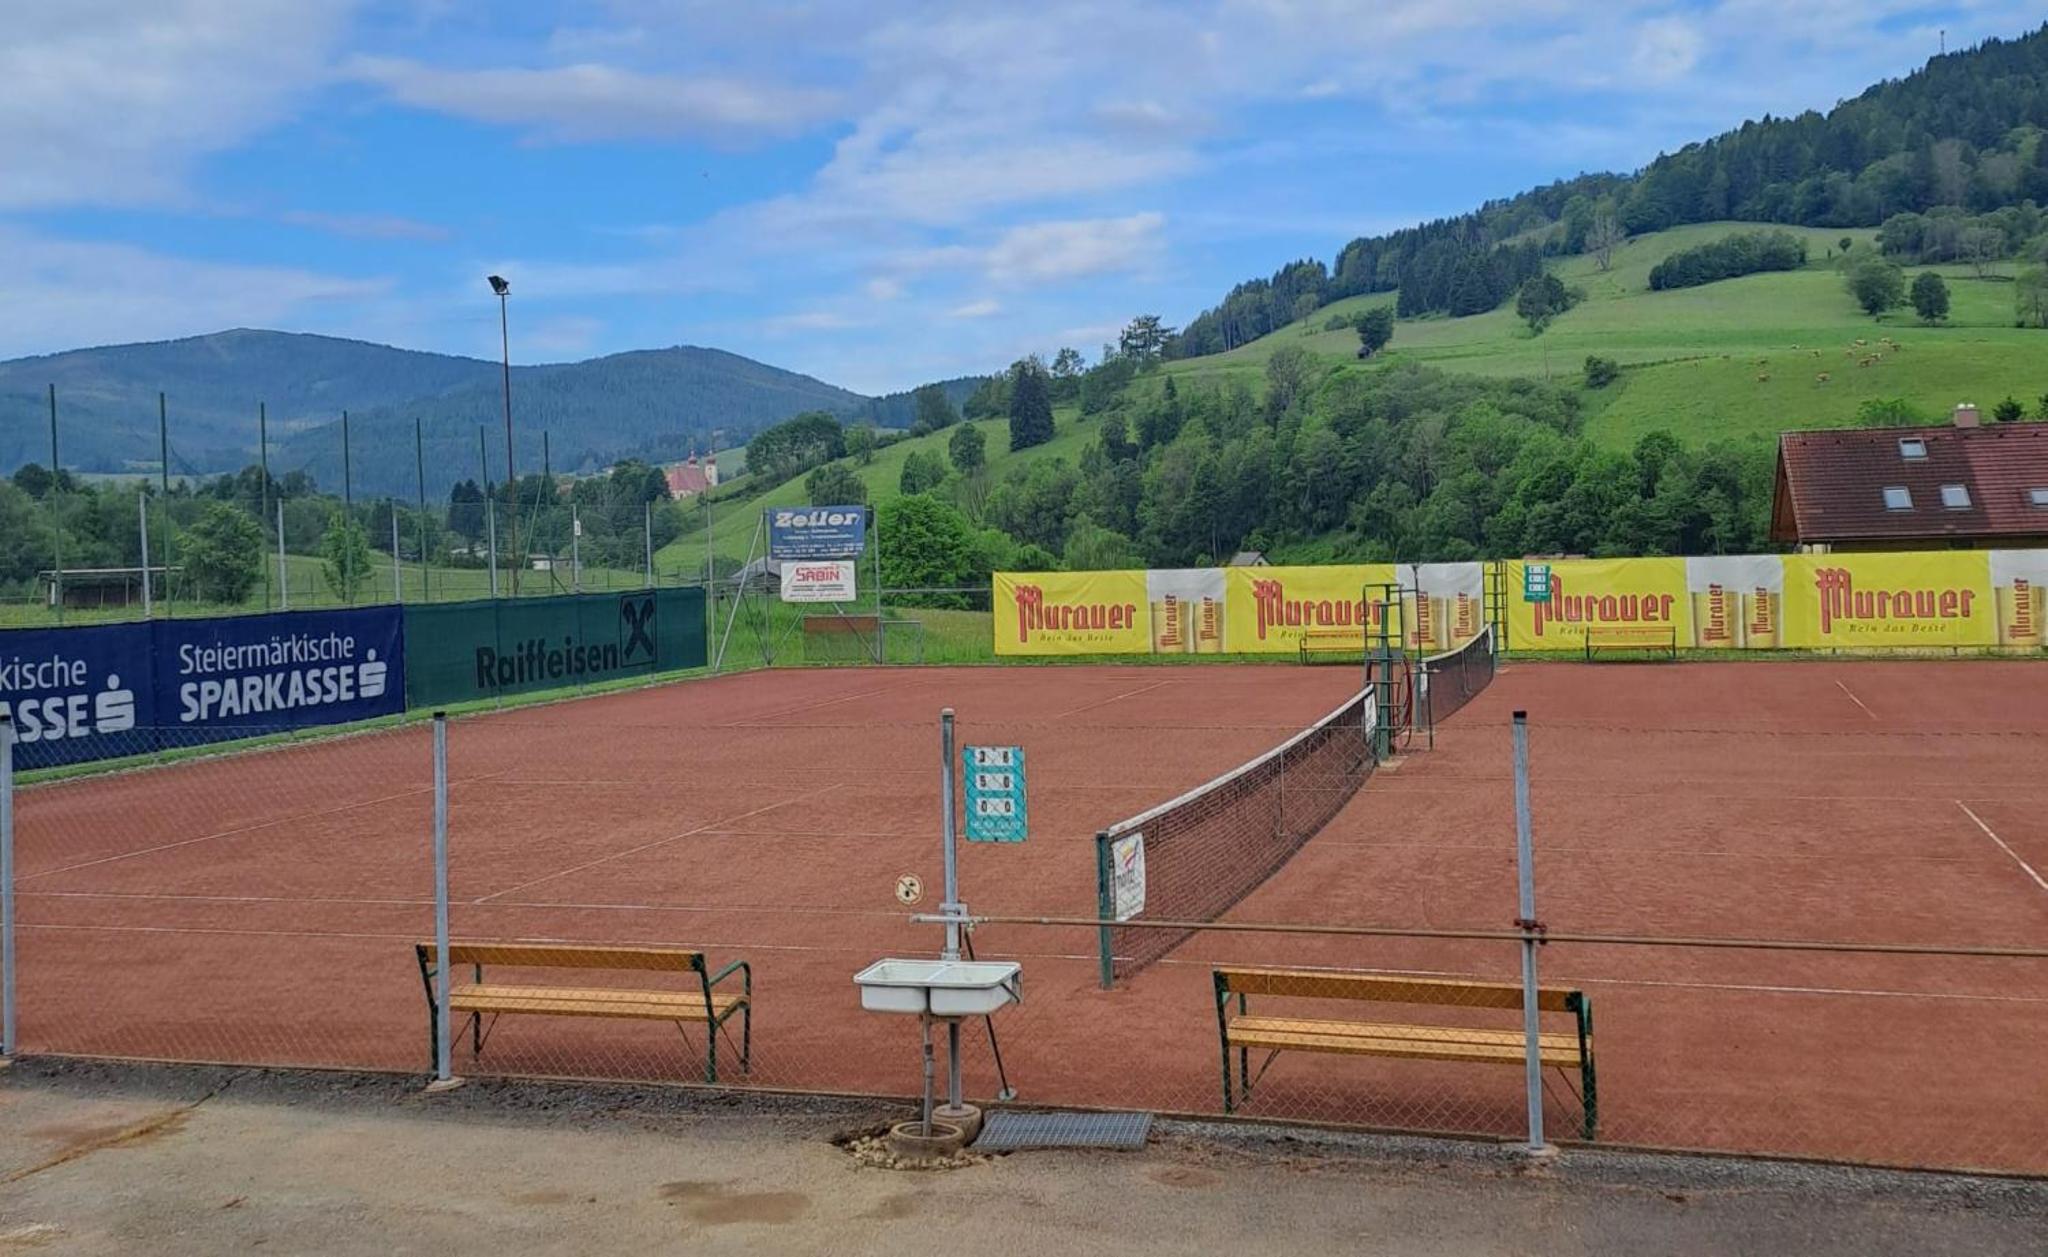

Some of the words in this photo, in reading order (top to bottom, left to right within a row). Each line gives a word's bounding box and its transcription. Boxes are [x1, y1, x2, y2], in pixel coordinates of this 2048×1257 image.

[1015, 585, 1136, 643] Murauer
[1160, 594, 1182, 647] Murauer
[1201, 596, 1218, 641] Murauer
[1704, 583, 1732, 642] Murauer
[1752, 586, 1774, 636] Murauer
[1815, 568, 1976, 634] Murauer
[2009, 578, 2037, 639] Murauer
[180, 632, 354, 675] Steiermärkische
[476, 636, 618, 688] Raiffeisen
[180, 665, 354, 722] SPARKASSE
